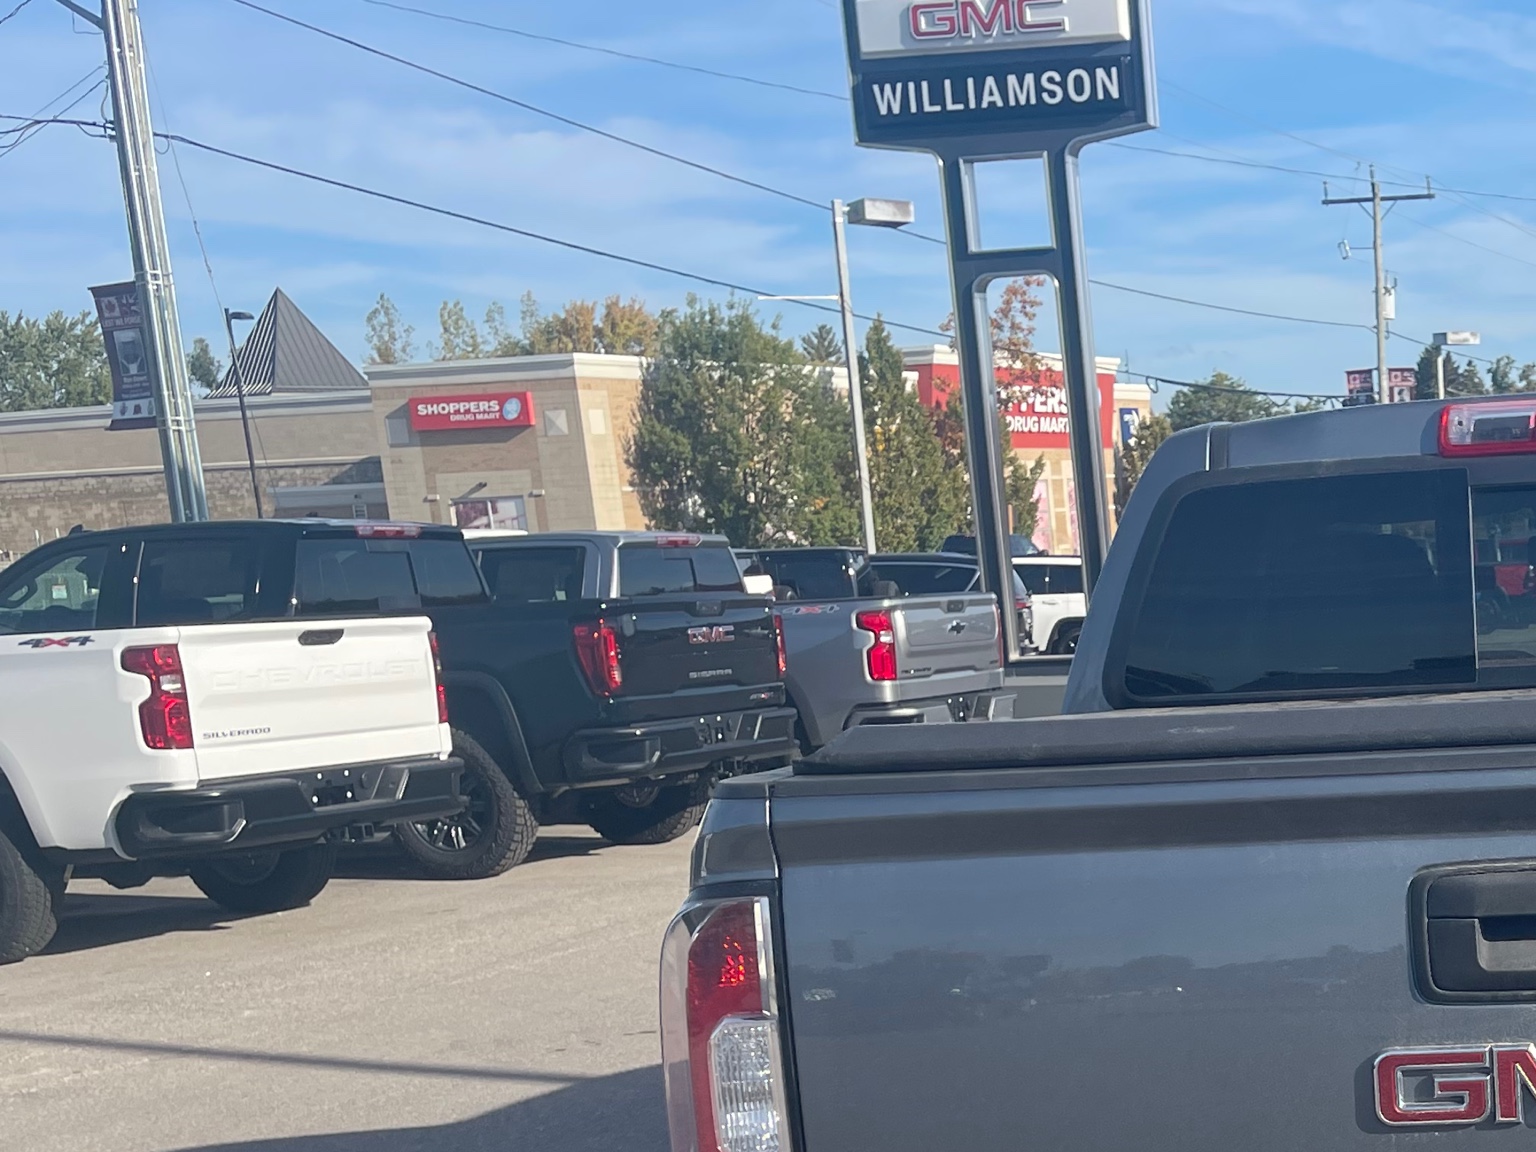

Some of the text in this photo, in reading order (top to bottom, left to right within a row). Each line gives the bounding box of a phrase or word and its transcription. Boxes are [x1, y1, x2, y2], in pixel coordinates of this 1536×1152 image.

[909, 0, 1070, 40] GMC
[872, 66, 1120, 116] WILLIAMSON
[417, 400, 500, 416] SHOPPERS
[449, 411, 500, 422] DRUG MART
[1005, 416, 1039, 434] DRUG
[688, 625, 735, 645] GMC
[211, 658, 421, 691] CHEVROLET
[689, 668, 733, 679] SIERRA
[203, 727, 271, 740] SILVERADO
